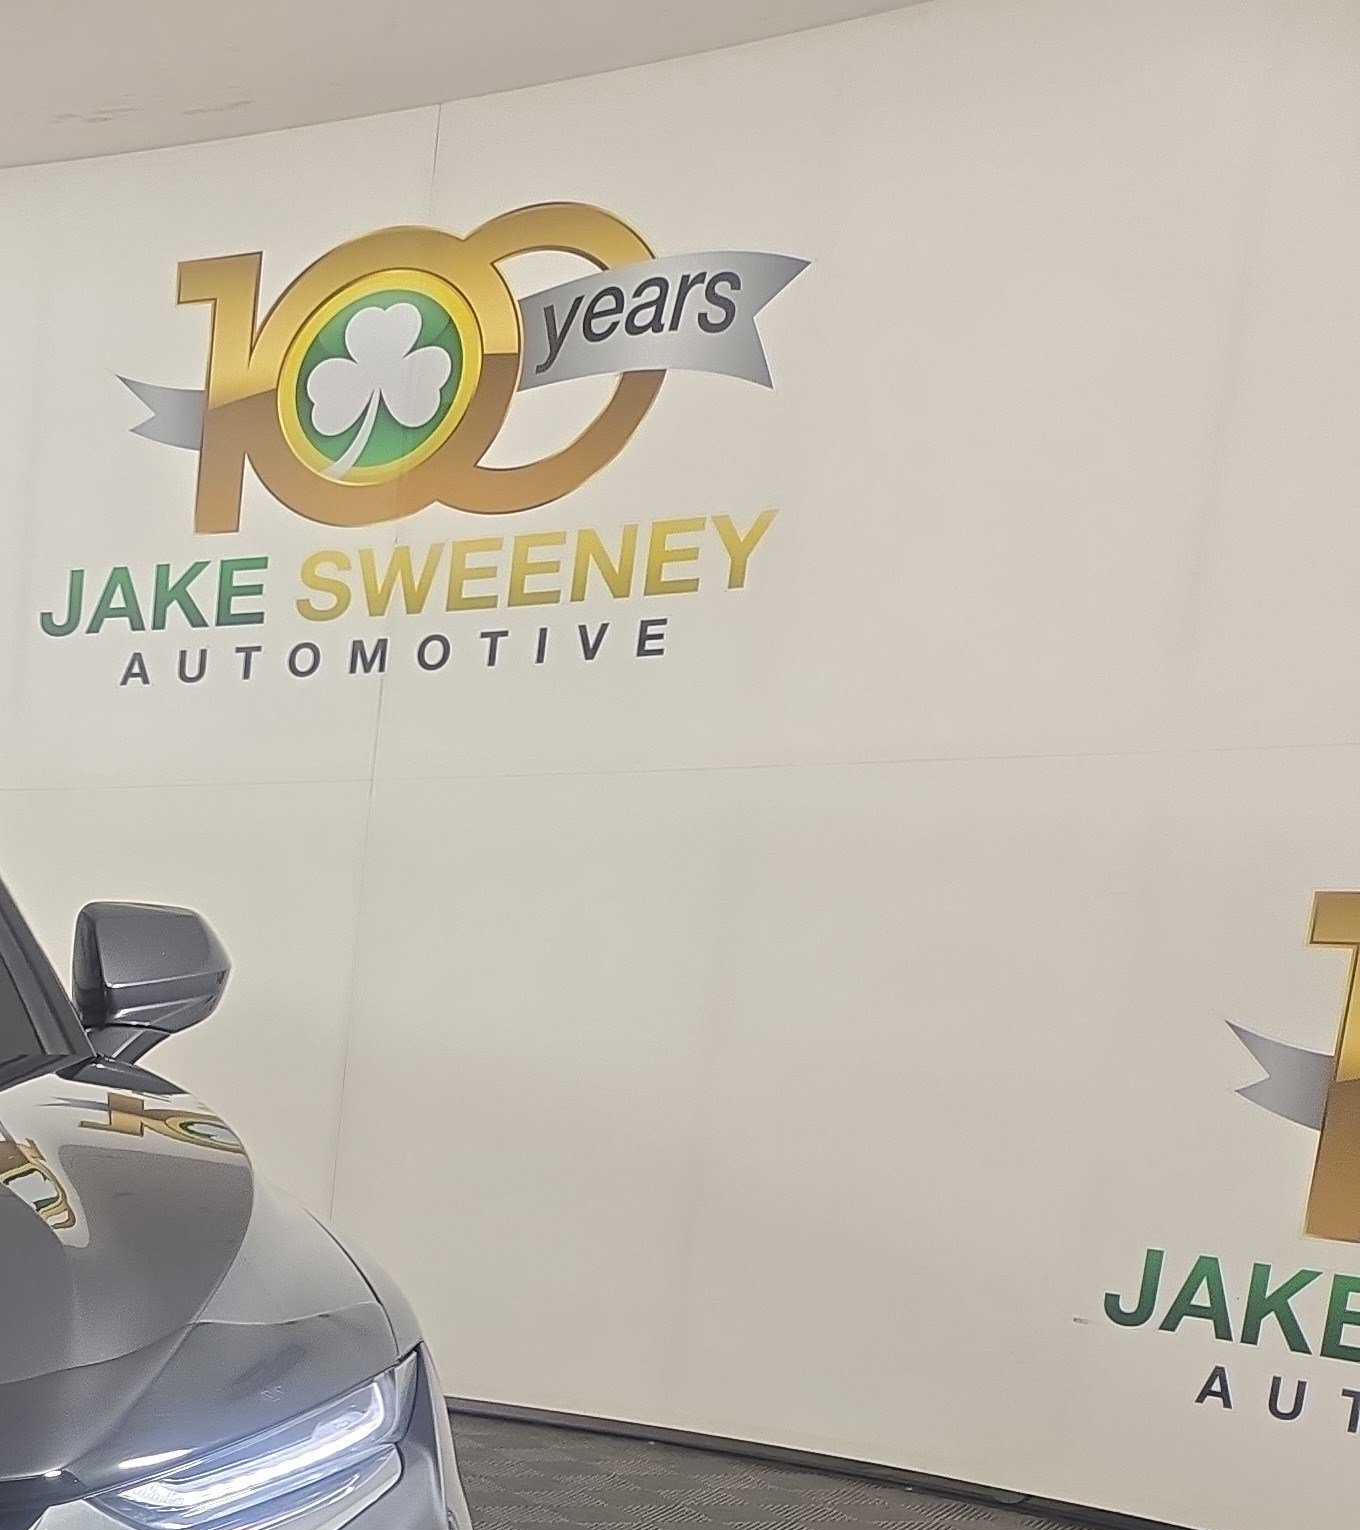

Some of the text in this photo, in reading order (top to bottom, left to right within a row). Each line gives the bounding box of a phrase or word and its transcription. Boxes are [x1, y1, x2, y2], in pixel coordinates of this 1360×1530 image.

[176, 201, 742, 534] 100 years
[39, 509, 780, 638] JAKE SWEENEY
[119, 618, 669, 687] AUTOMOTIVE
